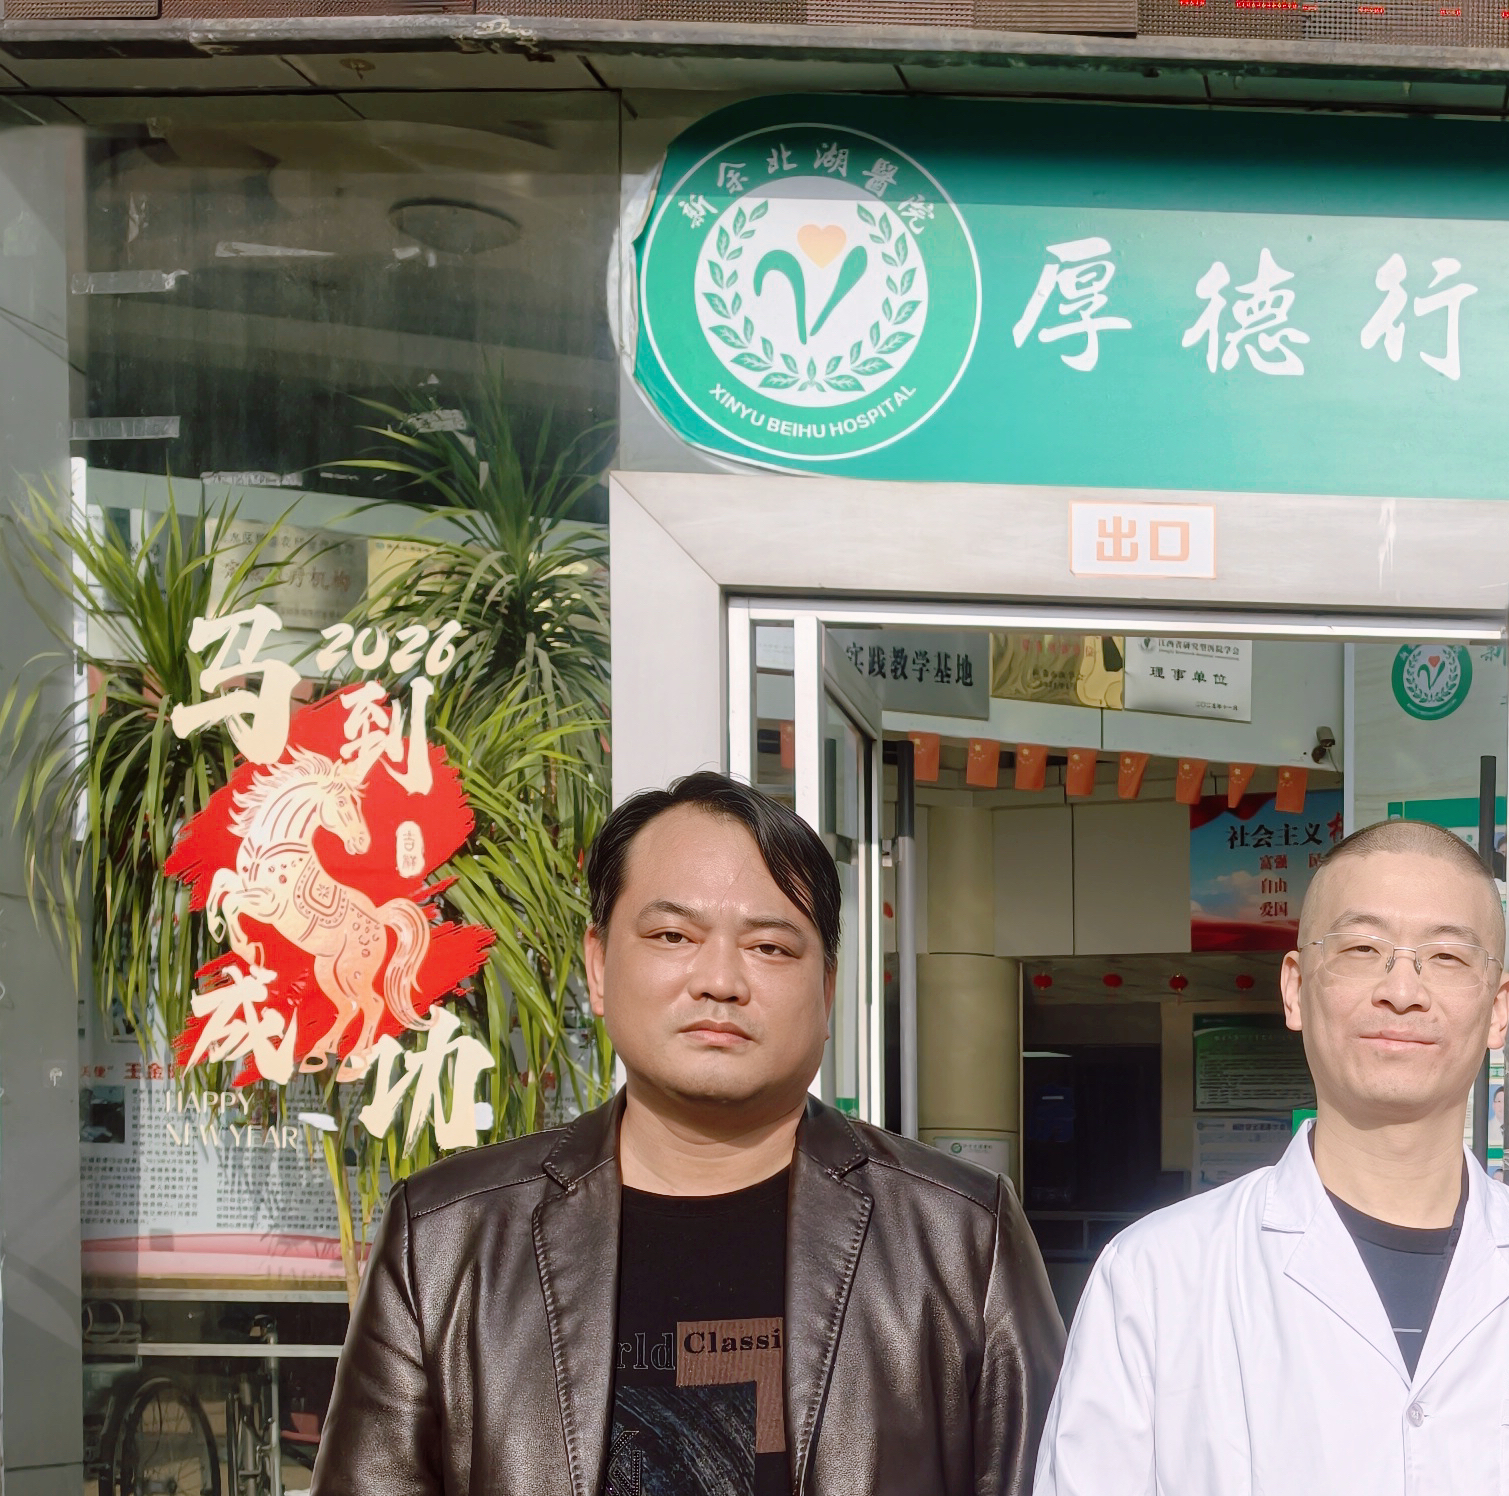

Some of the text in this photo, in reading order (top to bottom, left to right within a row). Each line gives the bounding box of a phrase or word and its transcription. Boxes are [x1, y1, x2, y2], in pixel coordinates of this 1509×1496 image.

[708, 382, 918, 439] XINYU BEIHU HOSPITAL
[1095, 514, 1191, 564] 出口
[315, 619, 463, 677] 2026
[1149, 666, 1228, 687] 理事单位
[1226, 822, 1323, 850] 社会主义
[1258, 853, 1289, 871] 富强
[1260, 877, 1288, 895] 自由
[1258, 900, 1289, 918] 爱国
[164, 1089, 255, 1115] HAPPY
[165, 1121, 299, 1150] NEW YEAR
[683, 1327, 782, 1355] Classi
